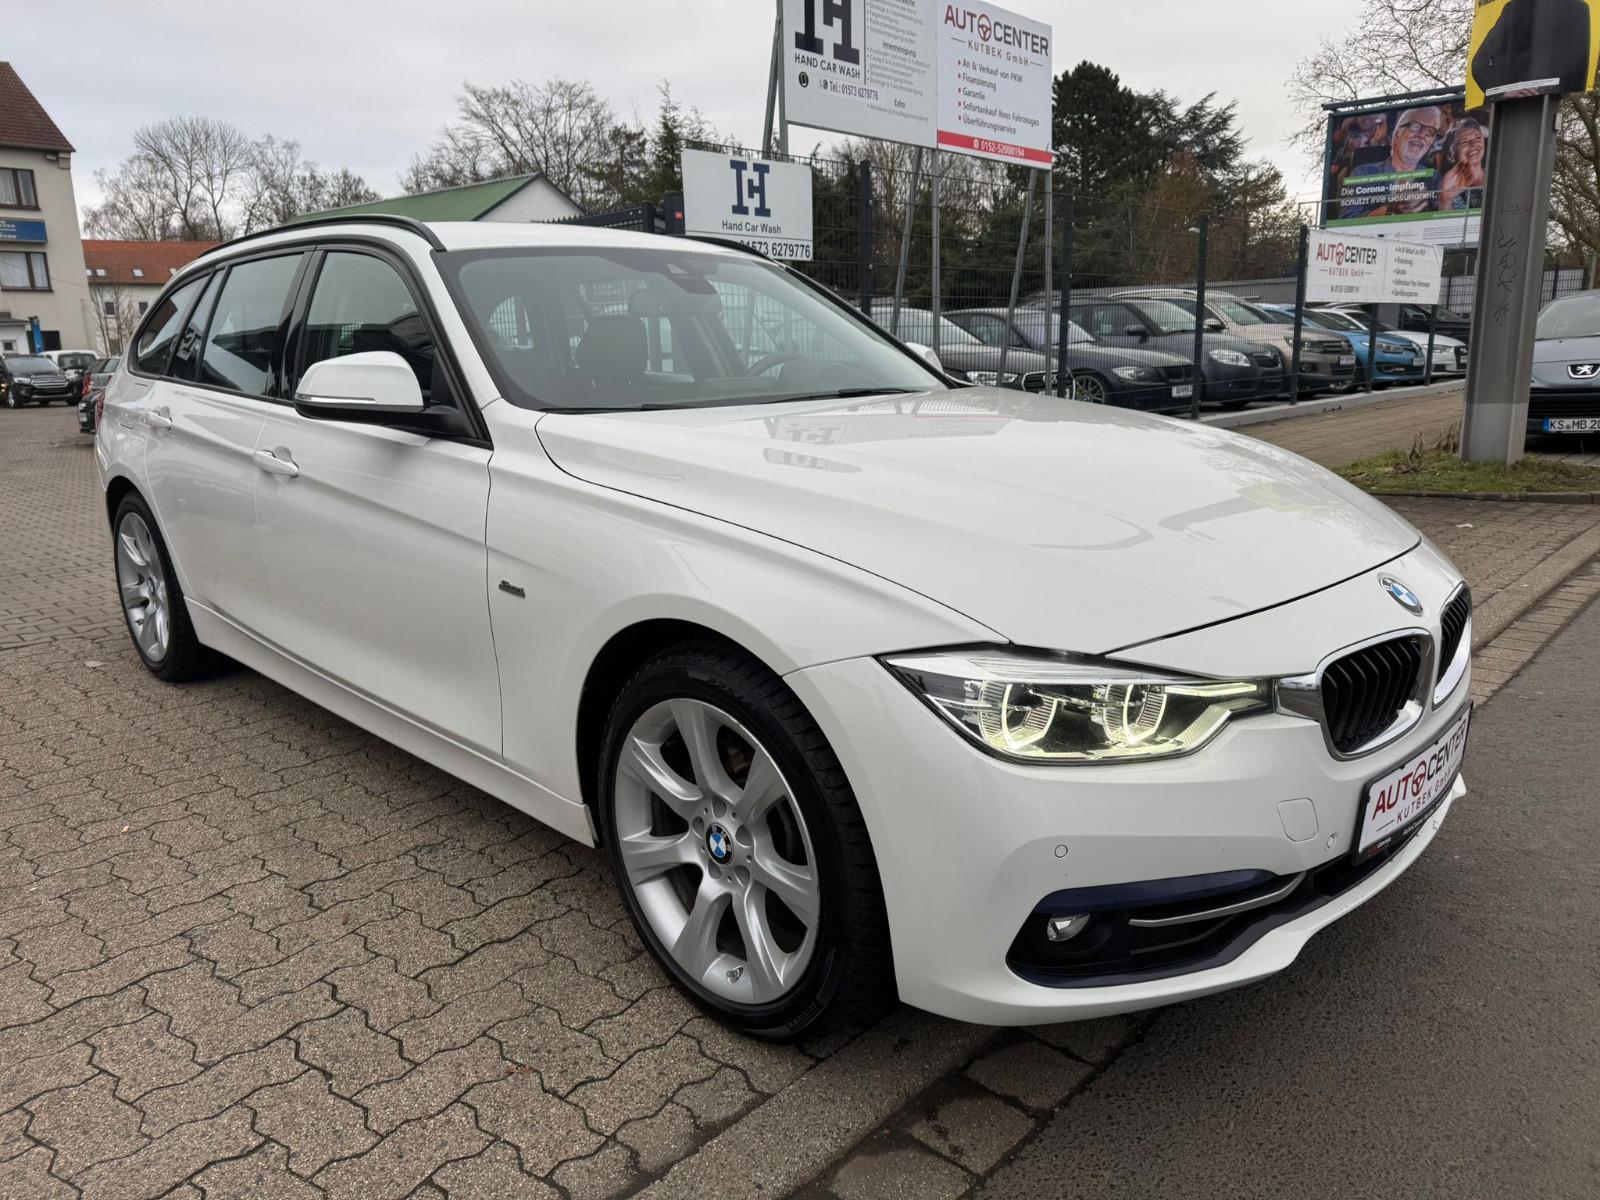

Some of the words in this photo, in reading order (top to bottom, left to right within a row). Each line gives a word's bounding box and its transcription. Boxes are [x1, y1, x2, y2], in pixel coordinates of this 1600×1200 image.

[944, 4, 1049, 57] AUTOCENTER
[967, 40, 1002, 59] KUTBEK
[1006, 52, 1029, 66] GmbH
[795, 53, 818, 68] HAND
[820, 60, 837, 73] CAR
[838, 65, 860, 79] WASH
[979, 63, 999, 76] Verkauf
[1000, 71, 1009, 79] von
[1010, 72, 1022, 82] PKW
[962, 73, 997, 92] Finanzierung
[962, 87, 986, 100] Garantie
[962, 101, 998, 116] Sofortankauf
[1012, 113, 1039, 128] Fahrzeuges
[1341, 187, 1355, 196] Die
[1355, 181, 1425, 195] Corona-Impfung
[722, 220, 743, 232] Hand
[745, 222, 759, 232] Car
[760, 223, 782, 234] Wash
[771, 242, 811, 258] 6279776
[1316, 243, 1378, 265] AUTOCENTER
[1550, 420, 1565, 430] KS
[1571, 420, 1588, 430] MB
[1372, 718, 1467, 821] AUTOCENTER
[1396, 788, 1432, 824] KUTBEK
